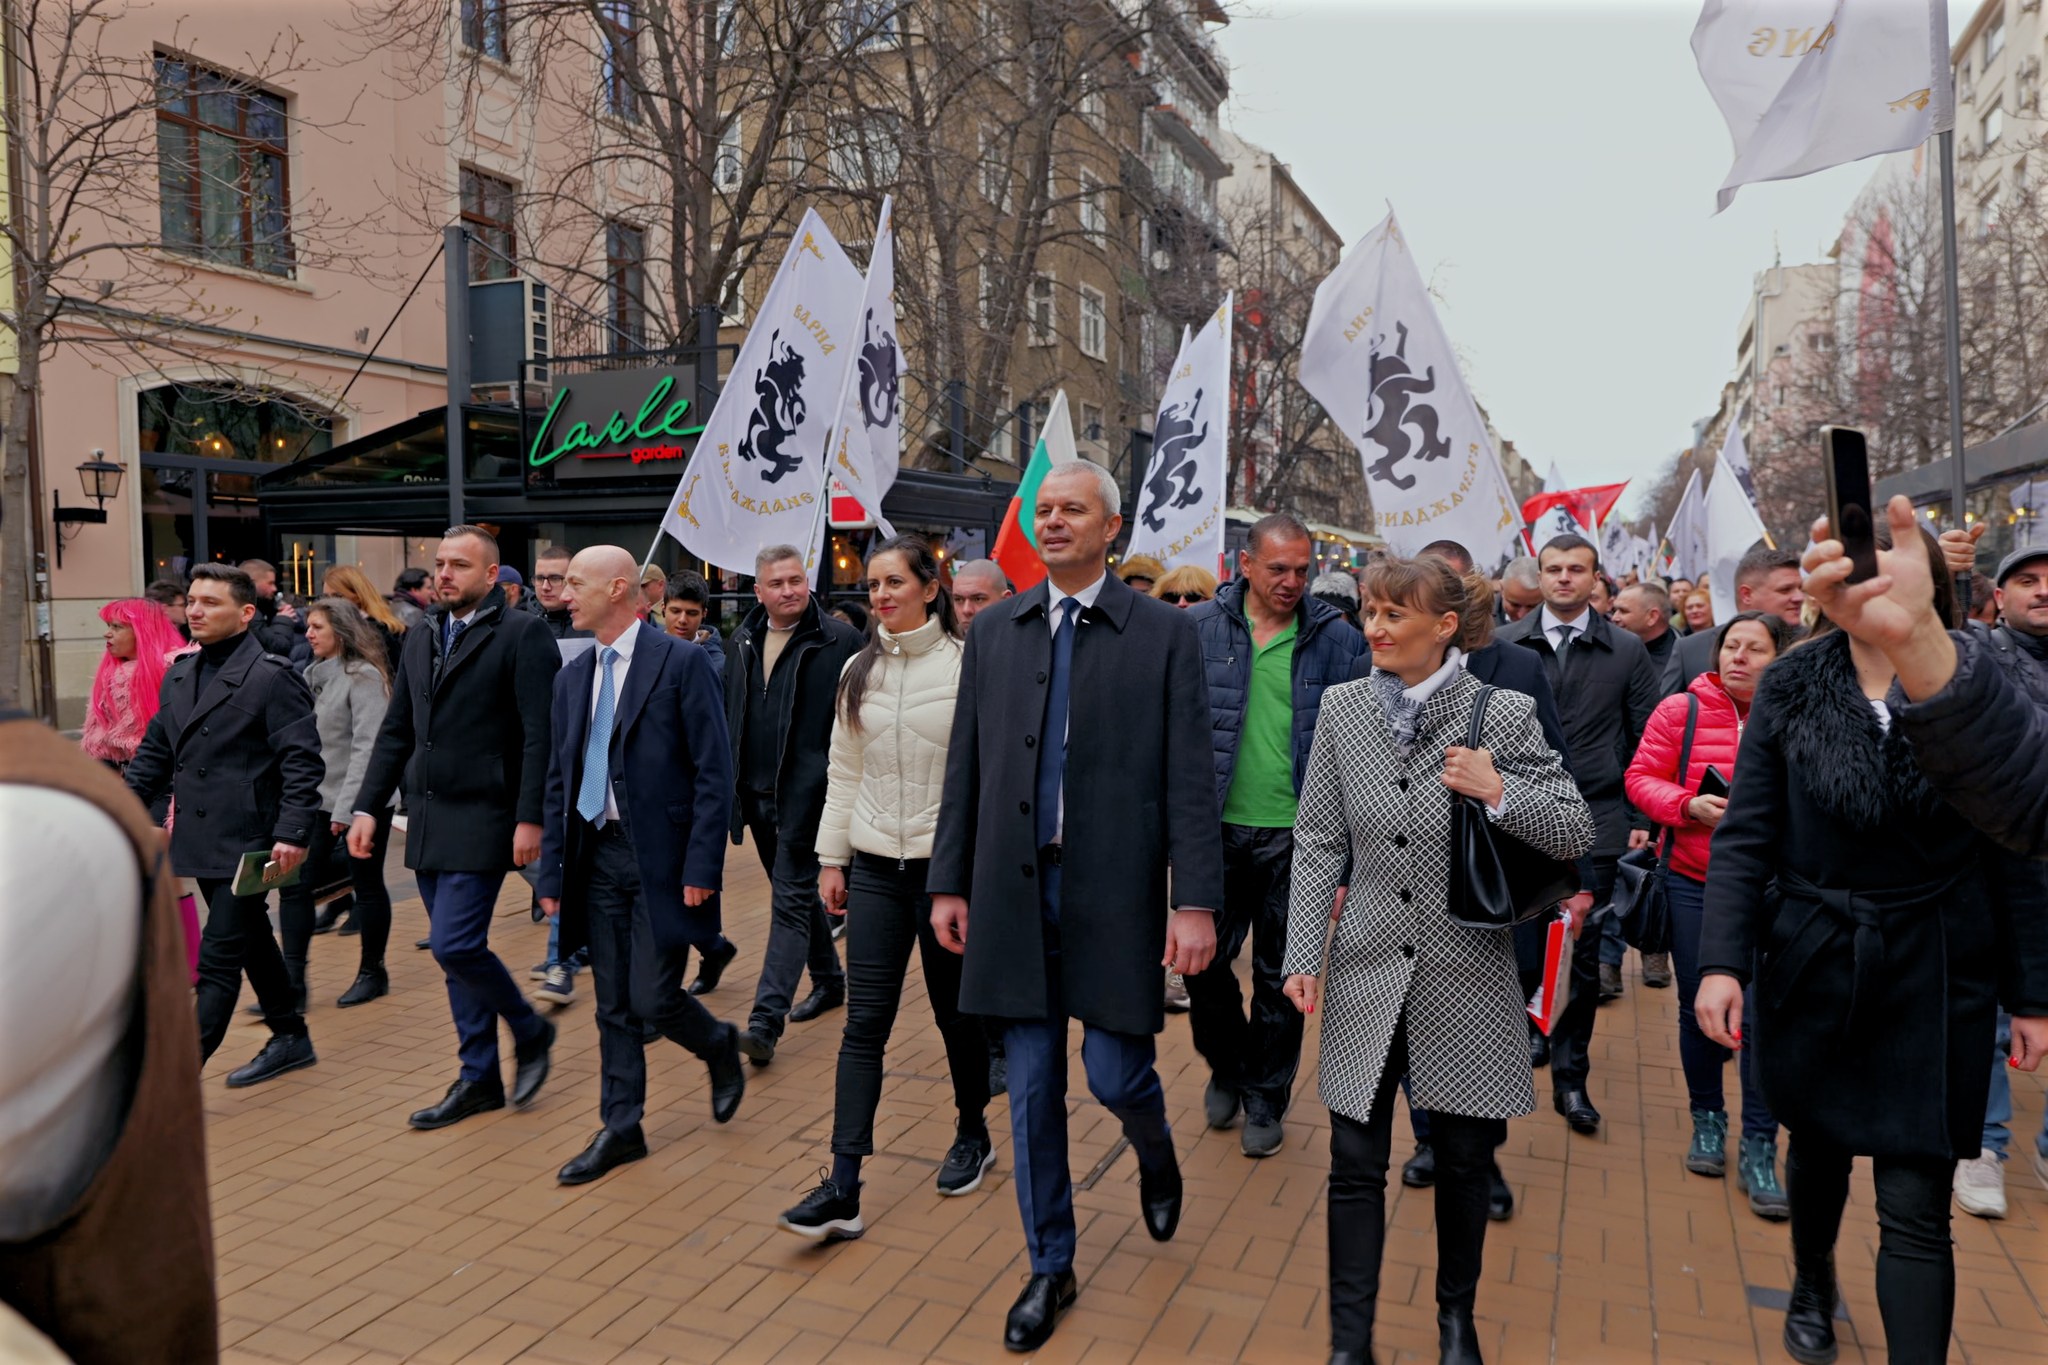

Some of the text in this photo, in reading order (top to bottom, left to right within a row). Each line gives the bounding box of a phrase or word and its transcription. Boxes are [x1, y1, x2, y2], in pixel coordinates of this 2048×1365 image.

[793, 303, 836, 357] ВАРНА
[630, 444, 683, 464] garden
[718, 443, 815, 516] ВЪРАЖДАНЕ
